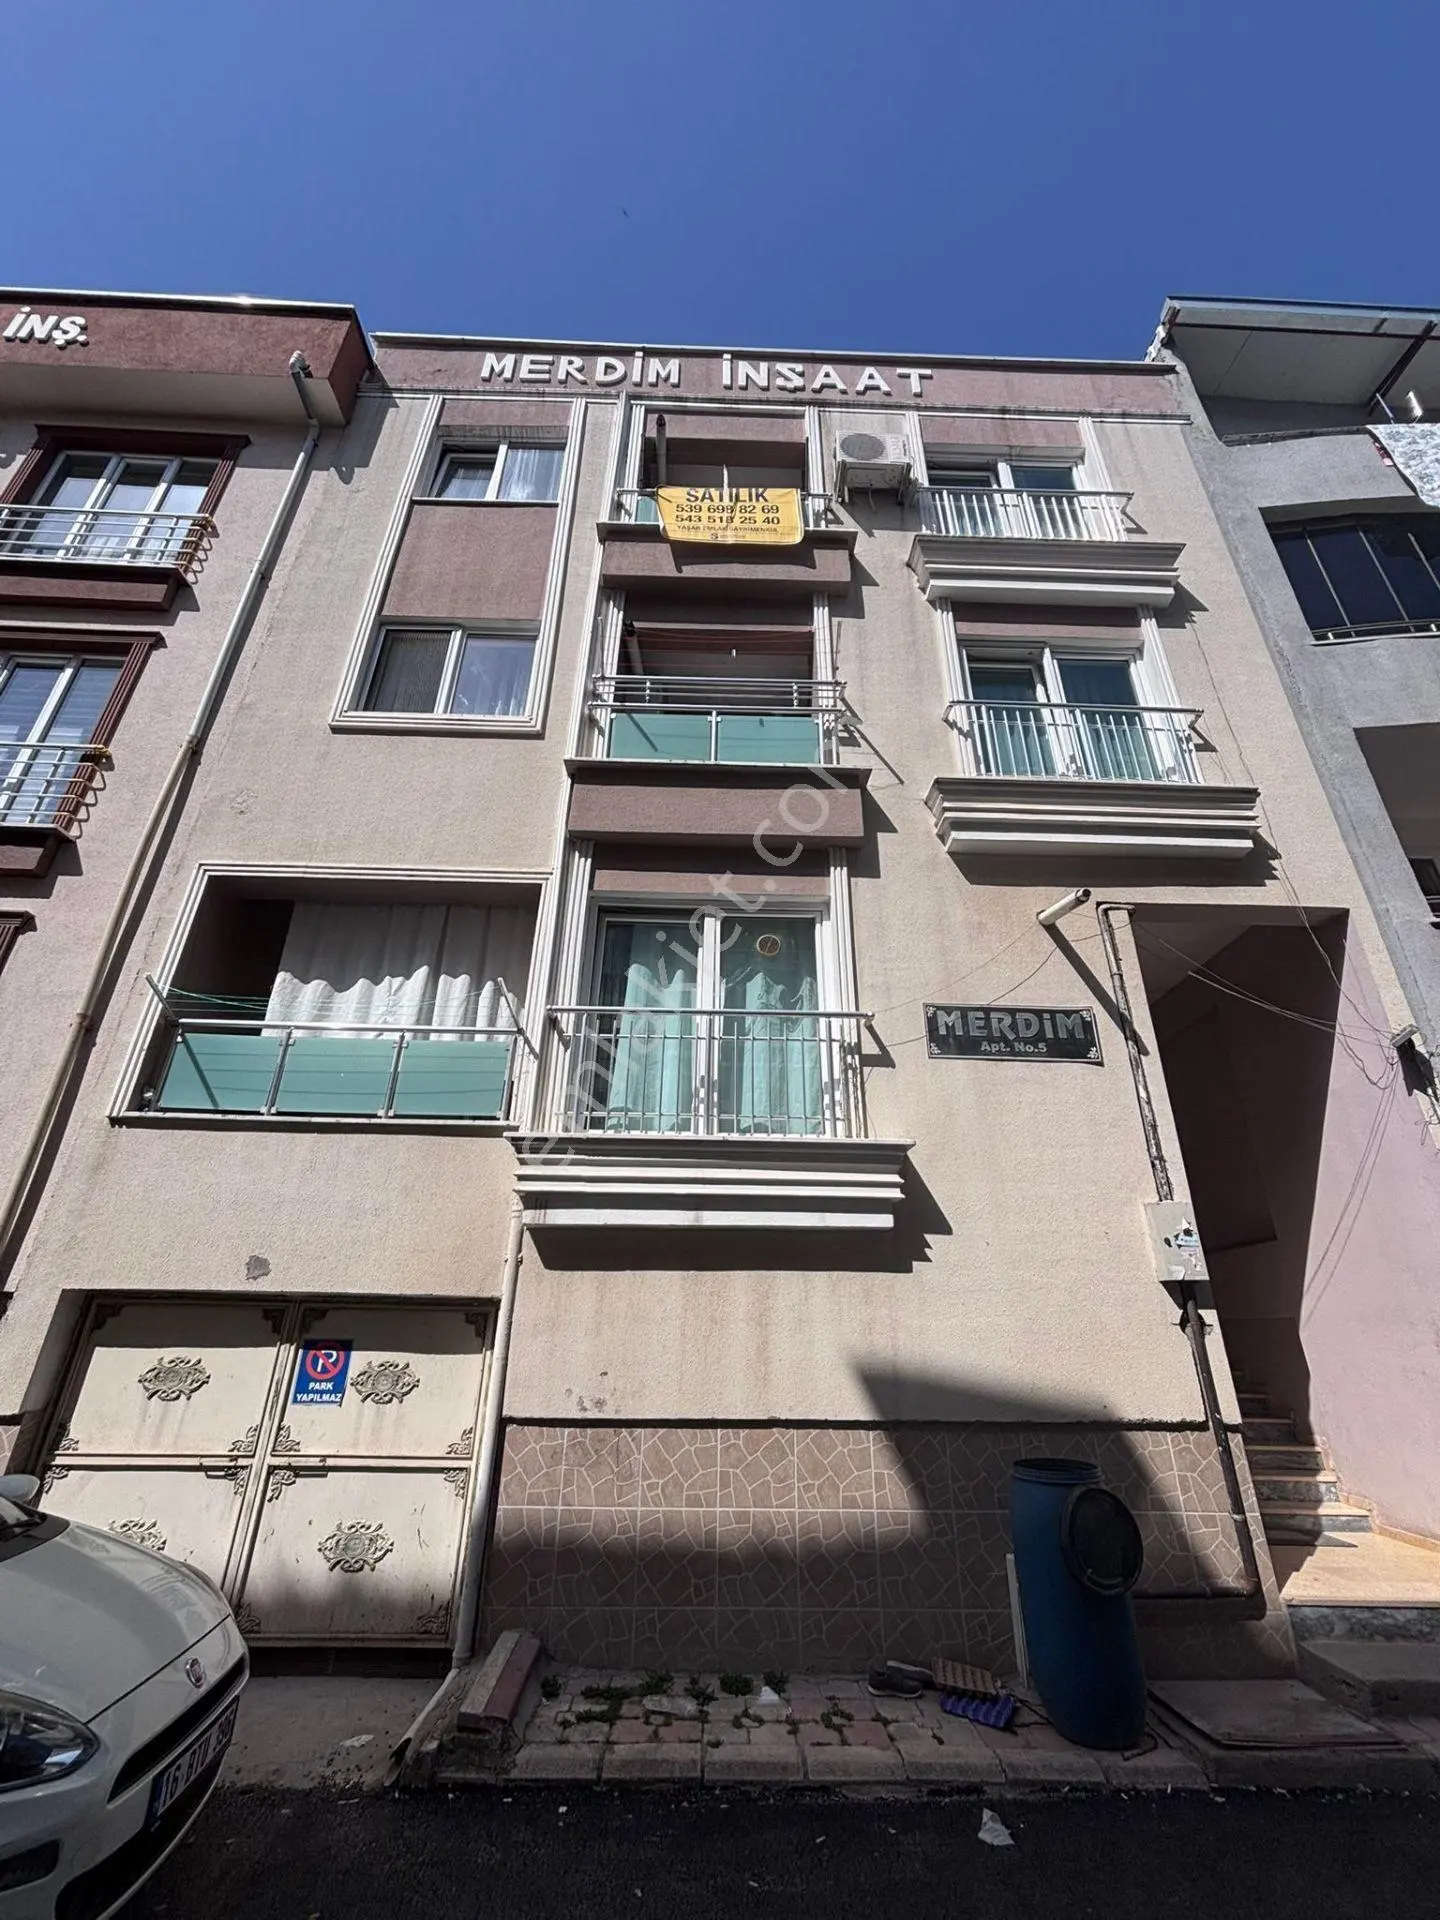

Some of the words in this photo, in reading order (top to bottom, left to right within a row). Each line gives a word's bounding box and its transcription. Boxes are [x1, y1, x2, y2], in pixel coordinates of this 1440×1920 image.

[2, 306, 88, 346] İNŞ.
[480, 351, 681, 388] MERDİM
[686, 488, 769, 503] SATILIK
[675, 504, 703, 514] 539
[739, 505, 757, 515] 82
[761, 505, 780, 515] 69
[675, 514, 702, 524] 543
[739, 516, 757, 525] 25
[761, 516, 780, 526] 40
[980, 1041, 1011, 1053] Apt.
[1014, 1042, 1047, 1053] No.5
[308, 1381, 334, 1391] PARK
[296, 1393, 342, 1402] YAPILMAZ
